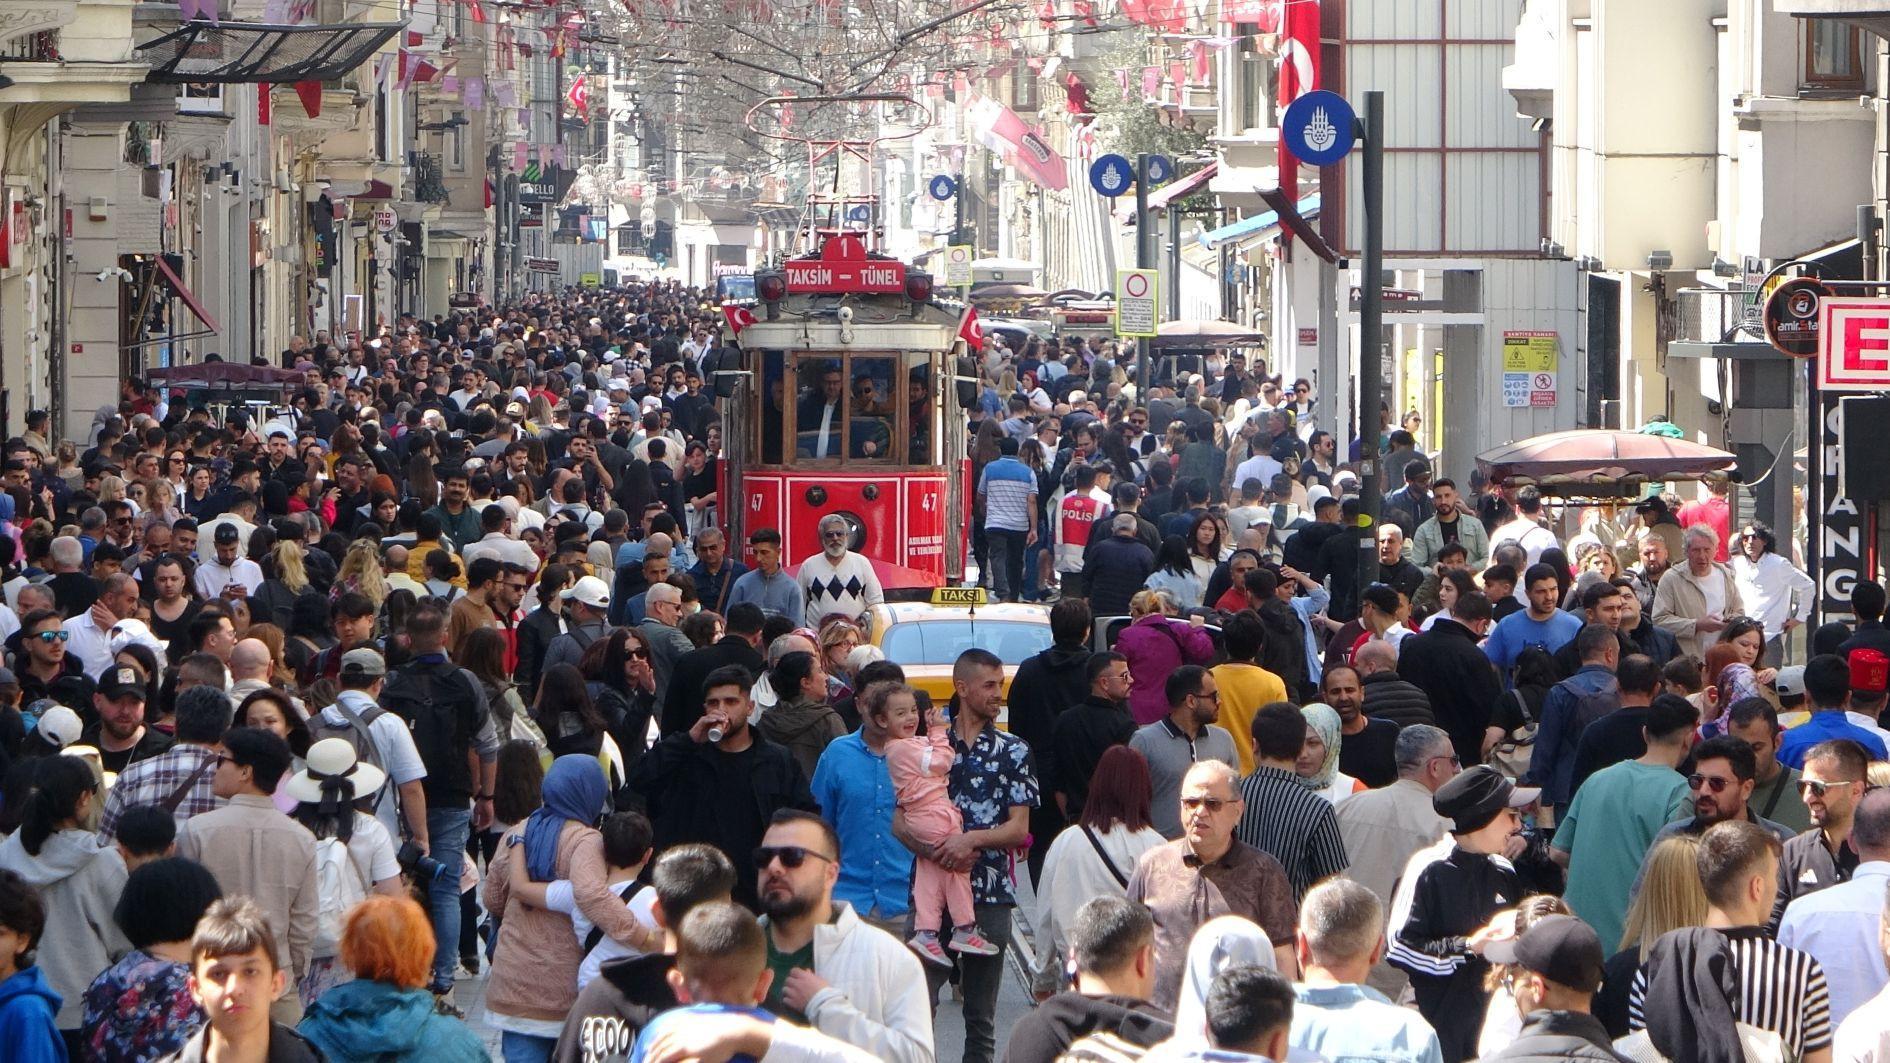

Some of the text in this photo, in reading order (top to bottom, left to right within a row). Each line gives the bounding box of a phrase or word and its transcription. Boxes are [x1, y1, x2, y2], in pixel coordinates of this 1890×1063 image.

[840, 238, 848, 258] 1
[786, 265, 832, 285] TAKSİM
[860, 265, 901, 286] TÜNEL
[1843, 317, 1889, 371] E
[751, 493, 764, 512] 47
[921, 492, 938, 512] 47
[941, 590, 980, 601] TAKSİ
